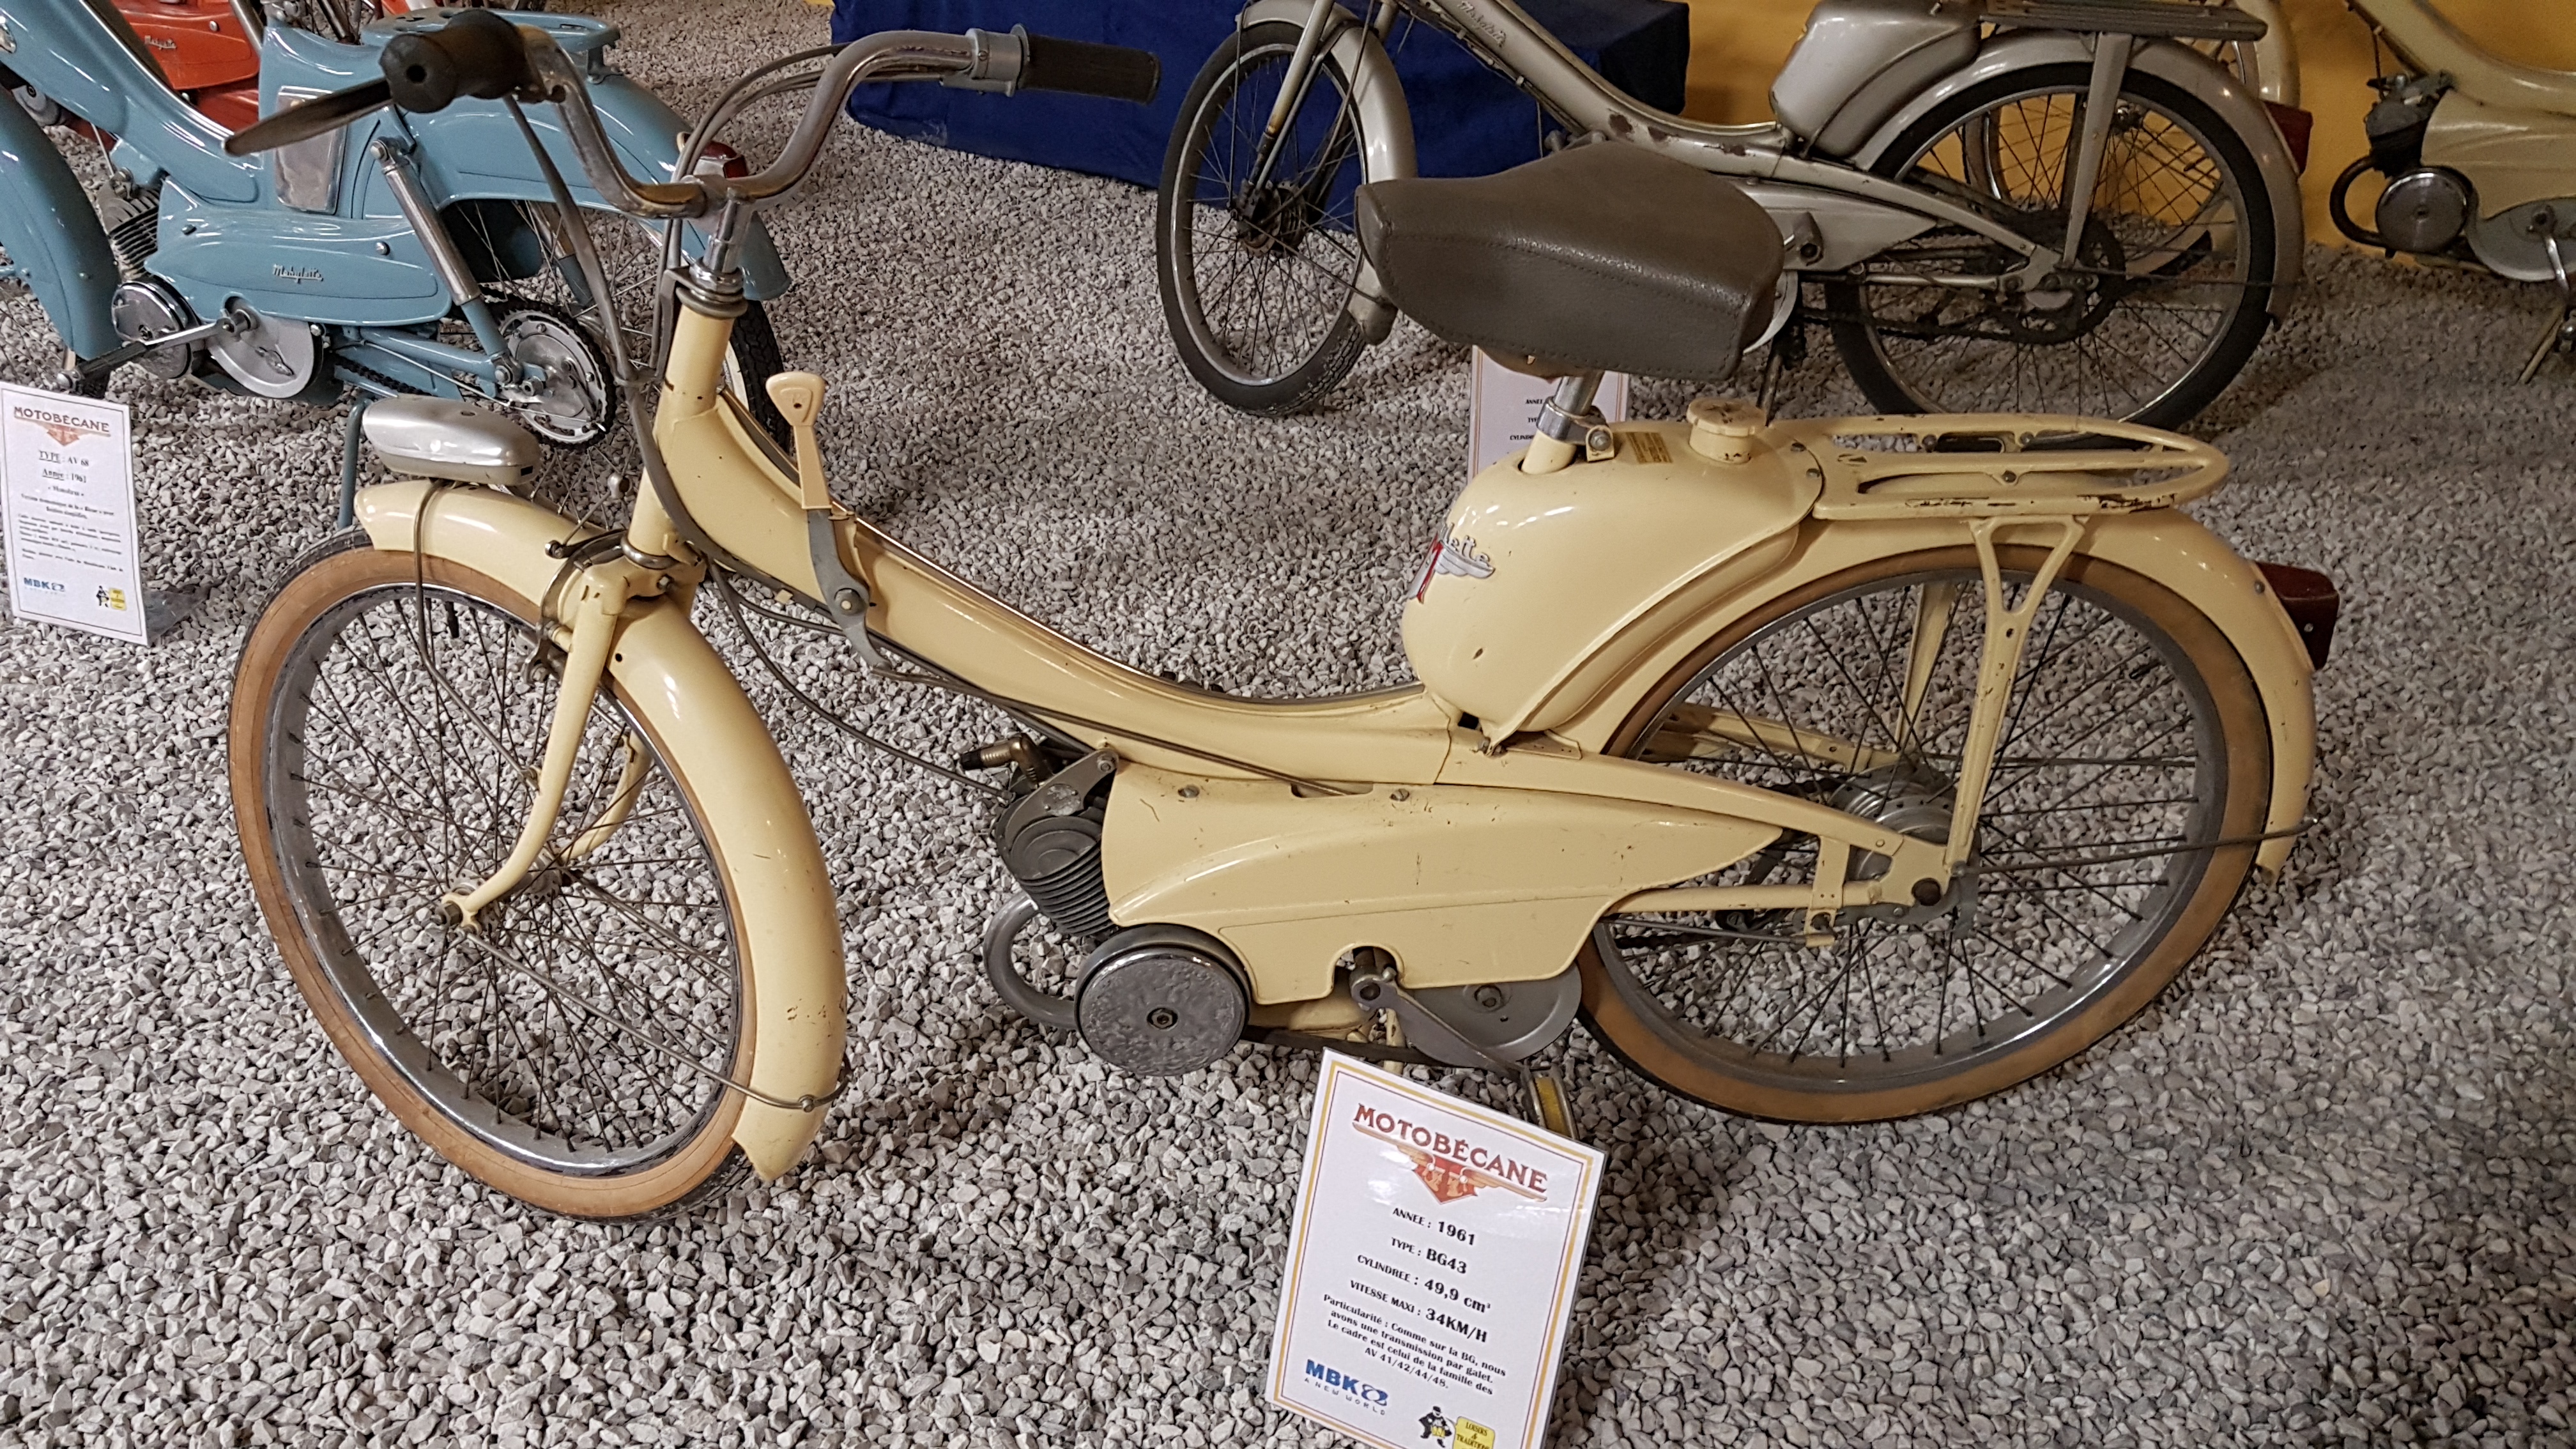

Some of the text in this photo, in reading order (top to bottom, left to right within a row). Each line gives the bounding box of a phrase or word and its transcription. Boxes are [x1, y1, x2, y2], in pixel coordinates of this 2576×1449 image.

[24, 577, 50, 590] MBK
[1353, 1103, 1548, 1193] MOTOBÉCANE
[1393, 1208, 1425, 1226] ANNEE
[1438, 1221, 1475, 1245] 1961
[1392, 1237, 1414, 1254] TYPE
[1426, 1248, 1467, 1274] BG43
[1358, 1255, 1411, 1282] CYLINDREE
[1425, 1279, 1459, 1300] 49,9
[1351, 1280, 1388, 1303] VITESSE
[1391, 1297, 1414, 1313] MAXI
[1425, 1308, 1487, 1343] 34KM/H
[1324, 1294, 1382, 1324] Particularité
[1392, 1322, 1427, 1344] Comme
[1429, 1340, 1446, 1351] sur
[1449, 1347, 1457, 1356] la
[1461, 1352, 1478, 1366] BG,
[1482, 1361, 1506, 1376] nous
[1331, 1310, 1358, 1326] avons
[1361, 1323, 1378, 1335] une
[1381, 1331, 1443, 1362] transmission
[1446, 1359, 1463, 1370] par
[1306, 1359, 1360, 1395] MBK
[1328, 1319, 1493, 1395] Le cadre est celui de la famille des
[1365, 1347, 1449, 1389] AV 41/42/44/48.
[1346, 1394, 1386, 1416] WORLD
